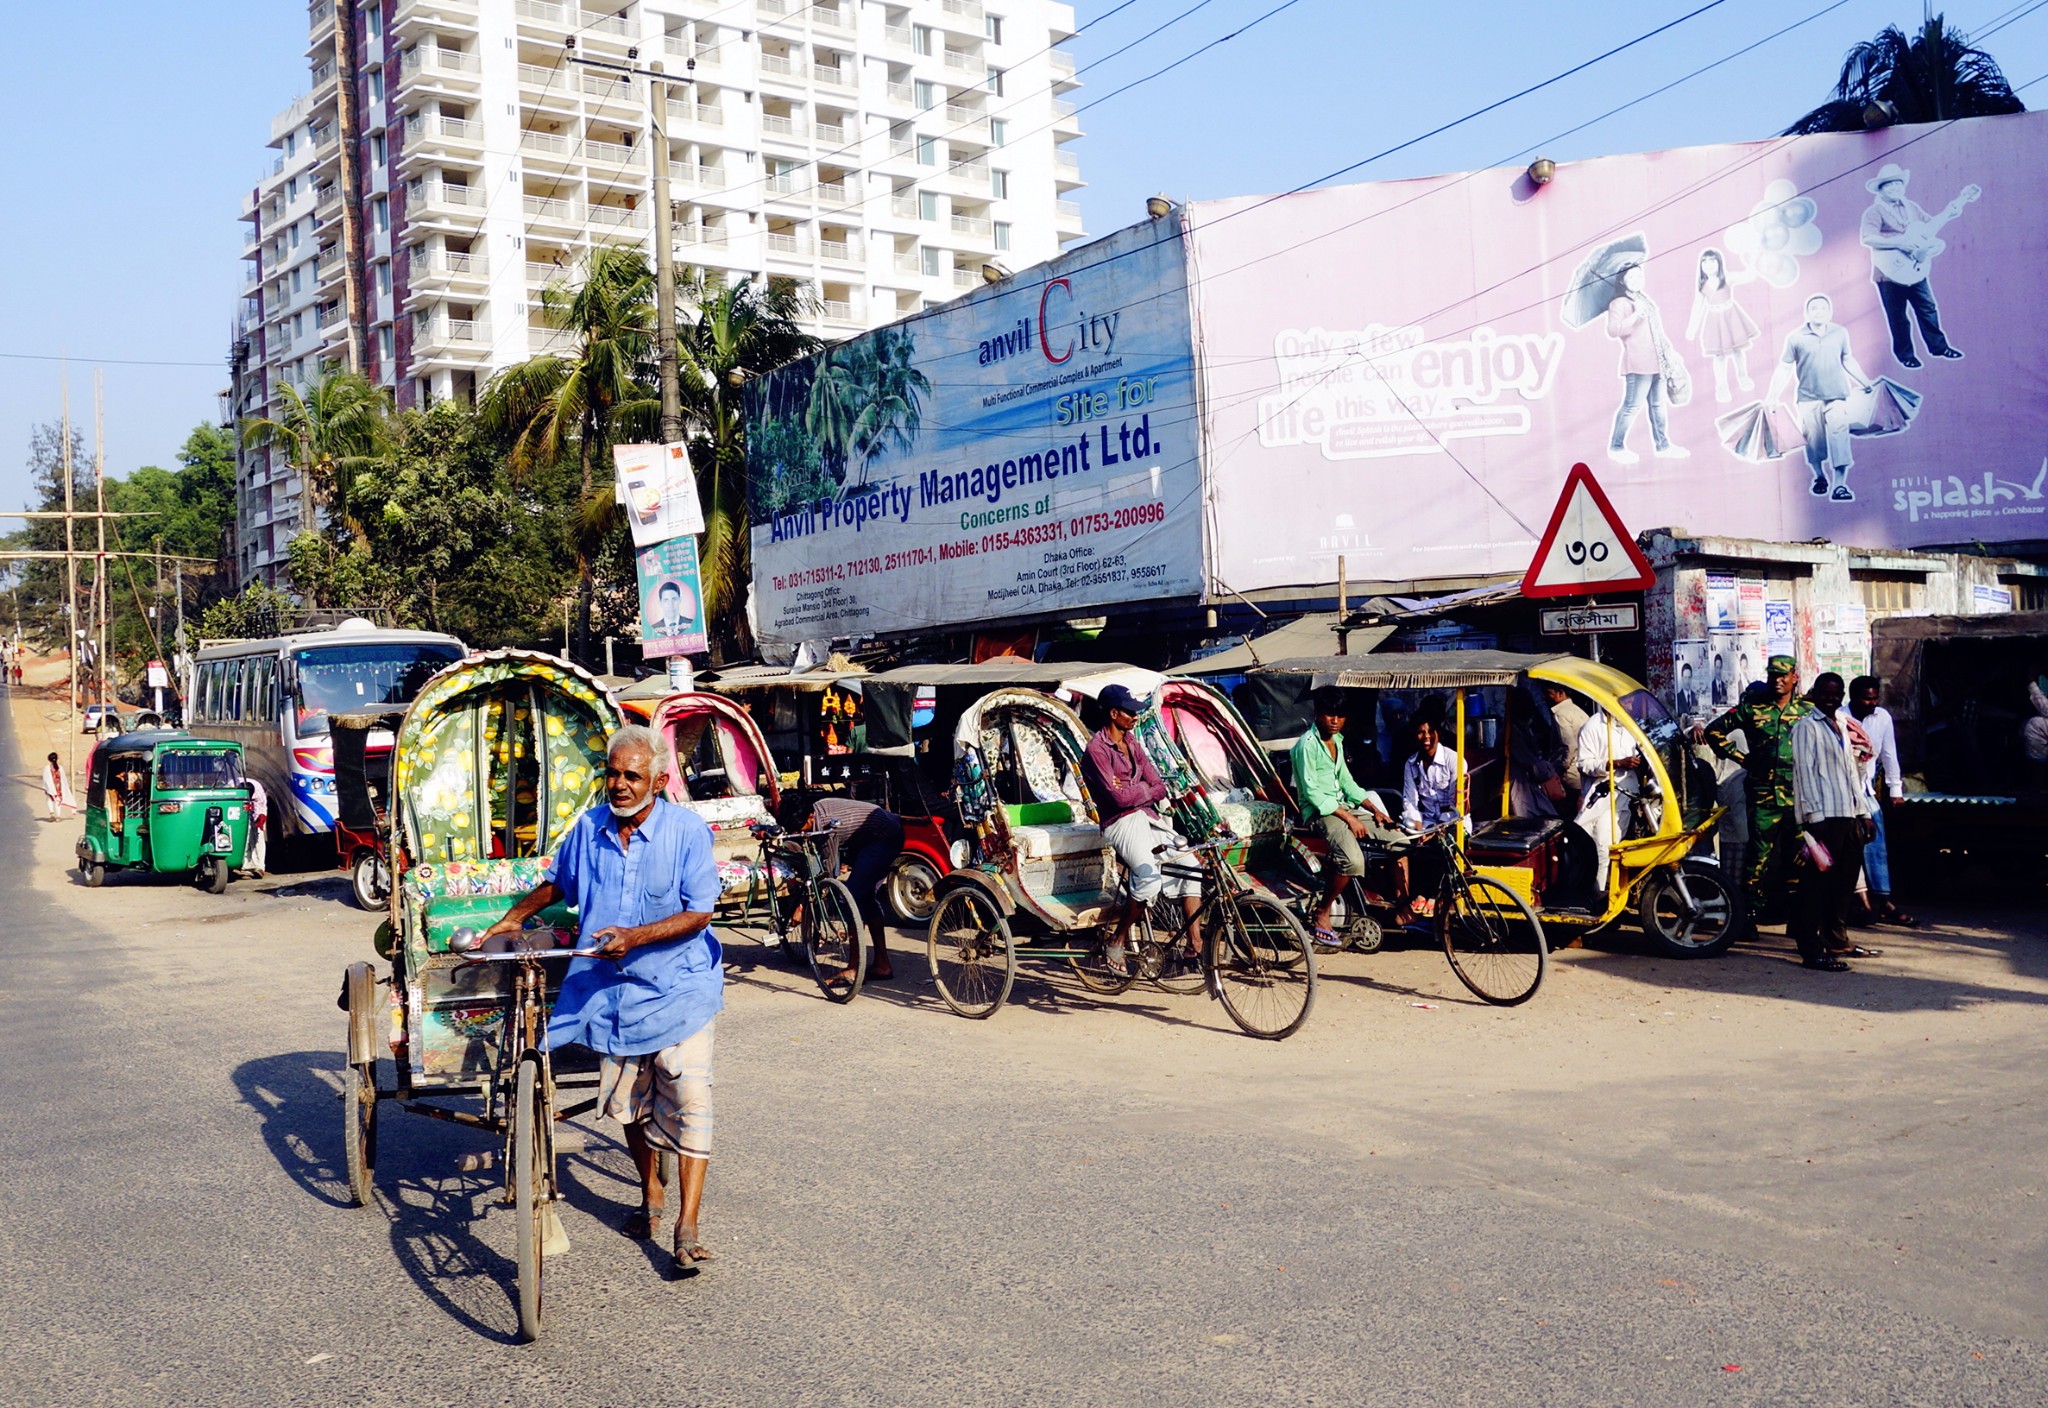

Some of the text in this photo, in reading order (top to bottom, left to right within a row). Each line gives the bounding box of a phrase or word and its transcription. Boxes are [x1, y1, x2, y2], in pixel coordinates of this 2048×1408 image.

[979, 278, 1120, 366] anvil City
[1282, 328, 1418, 362] Only a few
[996, 384, 1025, 404] Functional
[1025, 376, 1059, 396] Commercial
[1059, 369, 1084, 387] Complex
[1084, 366, 1090, 377] &
[1090, 356, 1123, 378] Apartment
[1287, 335, 1558, 397] people can enjoy
[1055, 374, 1159, 426] Site for
[1264, 393, 1444, 441] life this way.
[1359, 435, 1375, 446] and
[771, 503, 816, 543] Anvil
[821, 485, 912, 532] Property
[920, 435, 1091, 509] Management
[1101, 414, 1162, 466] Ltd.
[1892, 476, 1929, 488] ANVIL
[1893, 471, 2016, 522] splash
[960, 495, 1051, 531] Concerns of
[1923, 512, 1929, 520] a
[1931, 510, 1970, 520] happening
[1971, 508, 1992, 518] place
[772, 501, 1165, 591] Tel: 031-715311-2, 712130, 2511170-1, Mobile: 0155-4363331, 01753-200996
[1043, 547, 1095, 564] Dhaka Office:
[1320, 533, 1372, 550] ANVIL
[1565, 540, 1609, 565] ৩০
[1016, 555, 1127, 582] Amin Court (3rd Floor) 62-63,
[1021, 582, 1037, 596] C/A,
[1038, 579, 1064, 594] Dhaka,
[1130, 564, 1167, 579] 9558617
[796, 589, 823, 602] Chittagong
[832, 596, 848, 608] Floor)
[774, 617, 795, 629] Agrabad
[795, 612, 825, 625] Commercial
[840, 607, 870, 618] Chittagong
[1557, 611, 1618, 627] গতিসীমা
